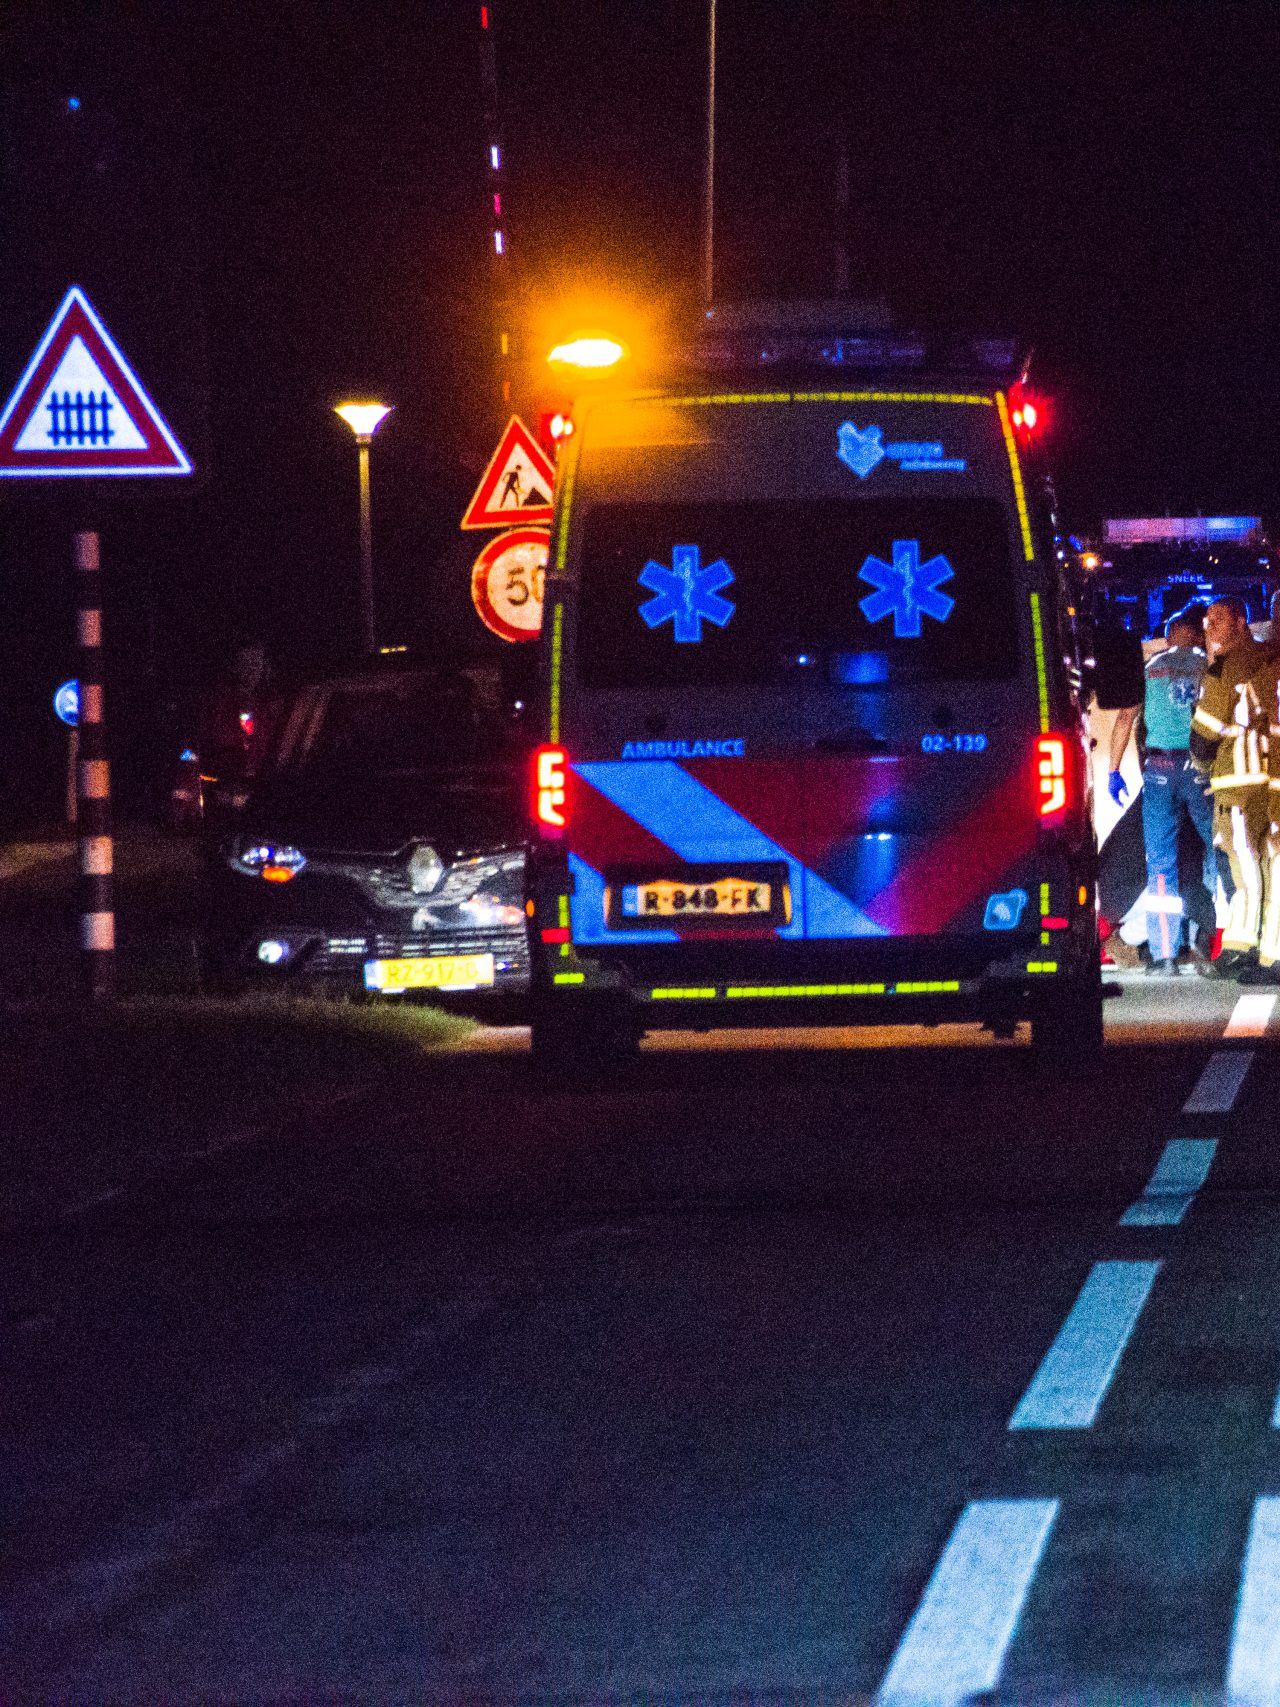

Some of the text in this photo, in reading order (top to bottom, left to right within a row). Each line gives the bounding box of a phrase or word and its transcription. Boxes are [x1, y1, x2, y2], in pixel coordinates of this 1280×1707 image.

[505, 564, 546, 607] 50
[1167, 574, 1204, 584] SNEEK
[621, 738, 745, 760] AMBULANCE
[921, 734, 989, 753] 02-139
[644, 886, 760, 912] R-848-FK
